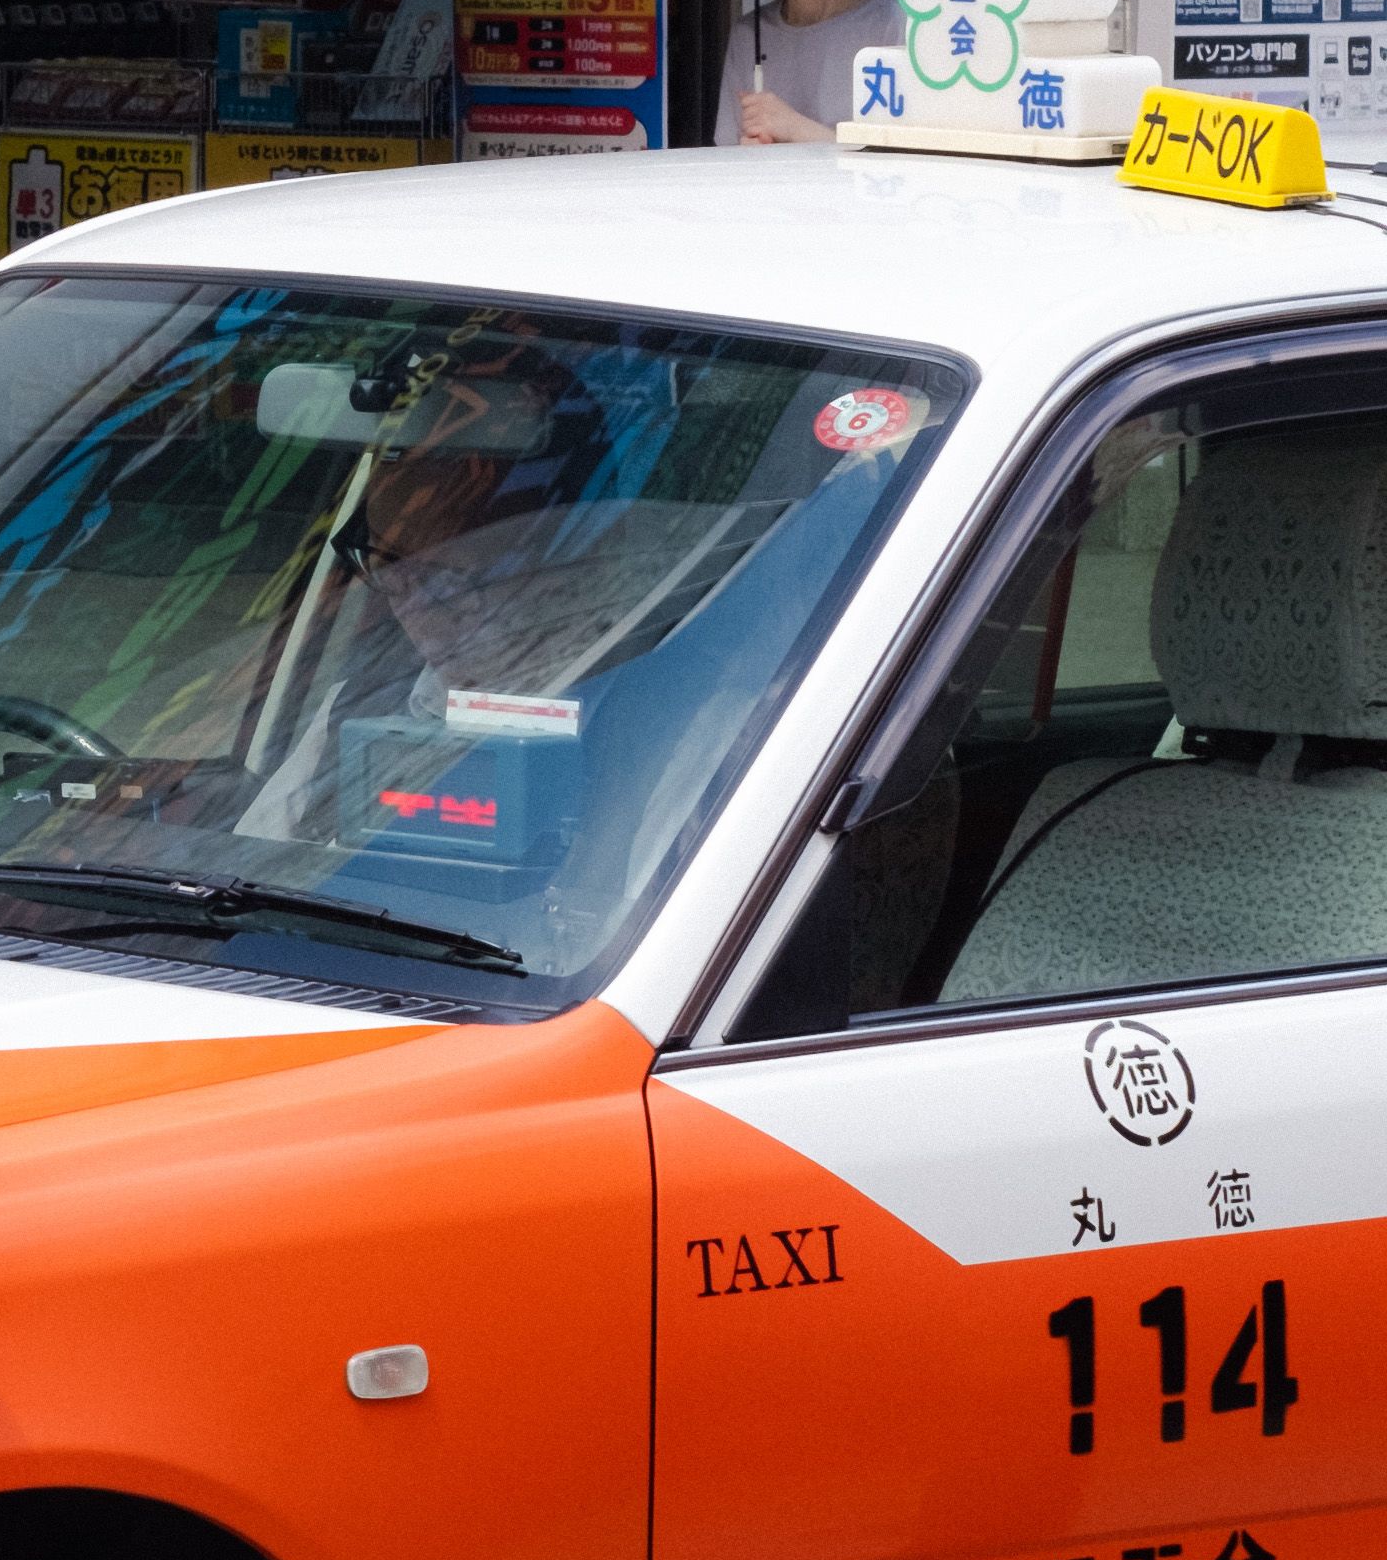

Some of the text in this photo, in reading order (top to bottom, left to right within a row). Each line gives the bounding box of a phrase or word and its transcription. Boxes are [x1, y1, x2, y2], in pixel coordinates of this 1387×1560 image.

[1185, 42, 1297, 63] パソコン専門館
[860, 58, 1065, 130] 丸 徳
[1133, 101, 1274, 185] カードOK
[1071, 1186, 1117, 1247] 丸
[687, 1224, 845, 1299] TAXI
[1048, 1279, 1299, 1457] 114
